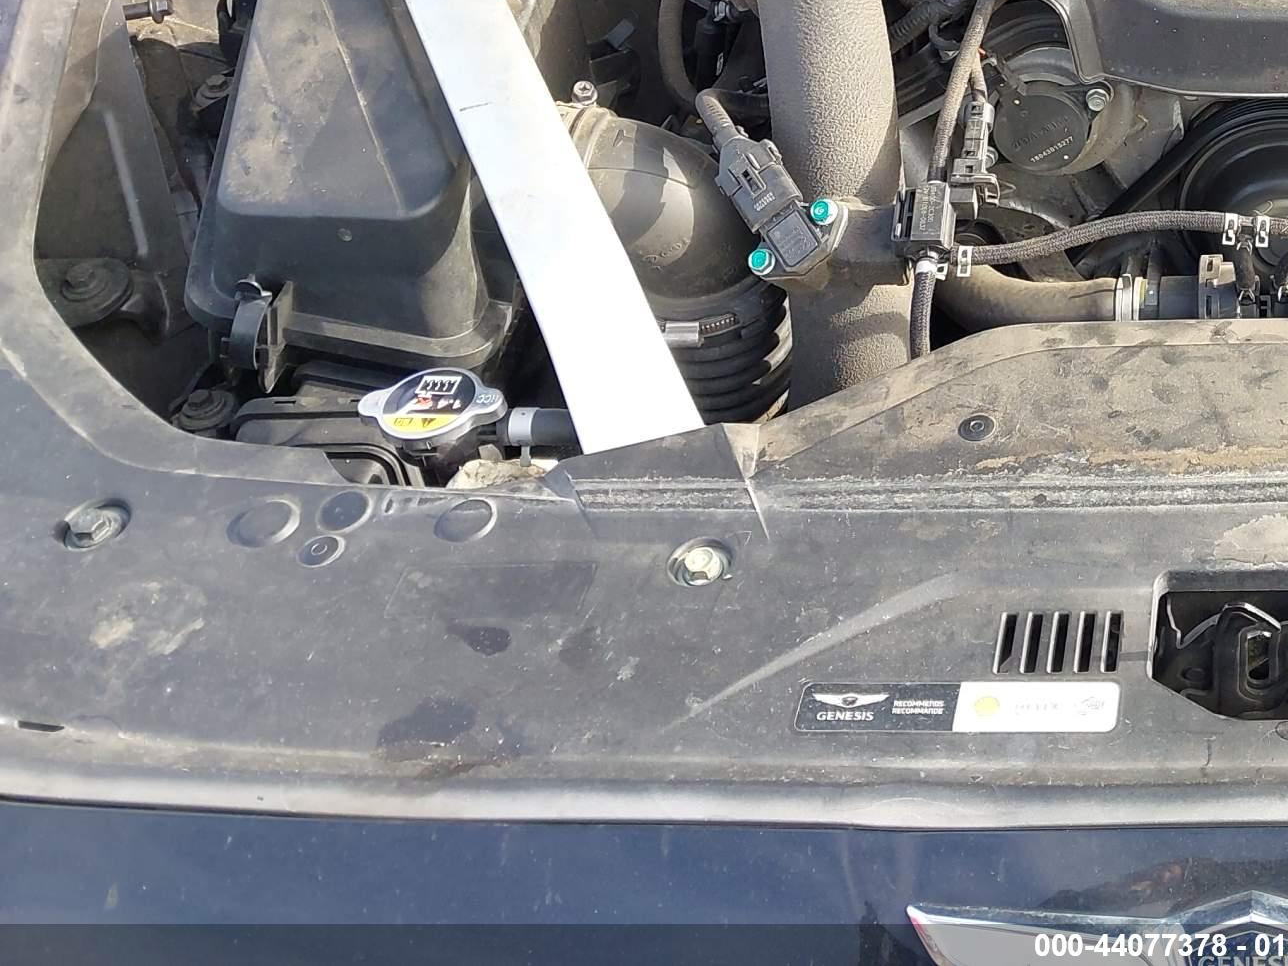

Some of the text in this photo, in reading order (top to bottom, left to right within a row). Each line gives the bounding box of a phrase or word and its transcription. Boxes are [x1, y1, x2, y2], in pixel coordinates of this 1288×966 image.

[892, 699, 945, 708] RECOMMENDS
[891, 707, 944, 715] RECOMMANDE
[816, 711, 874, 721] GENESIS
